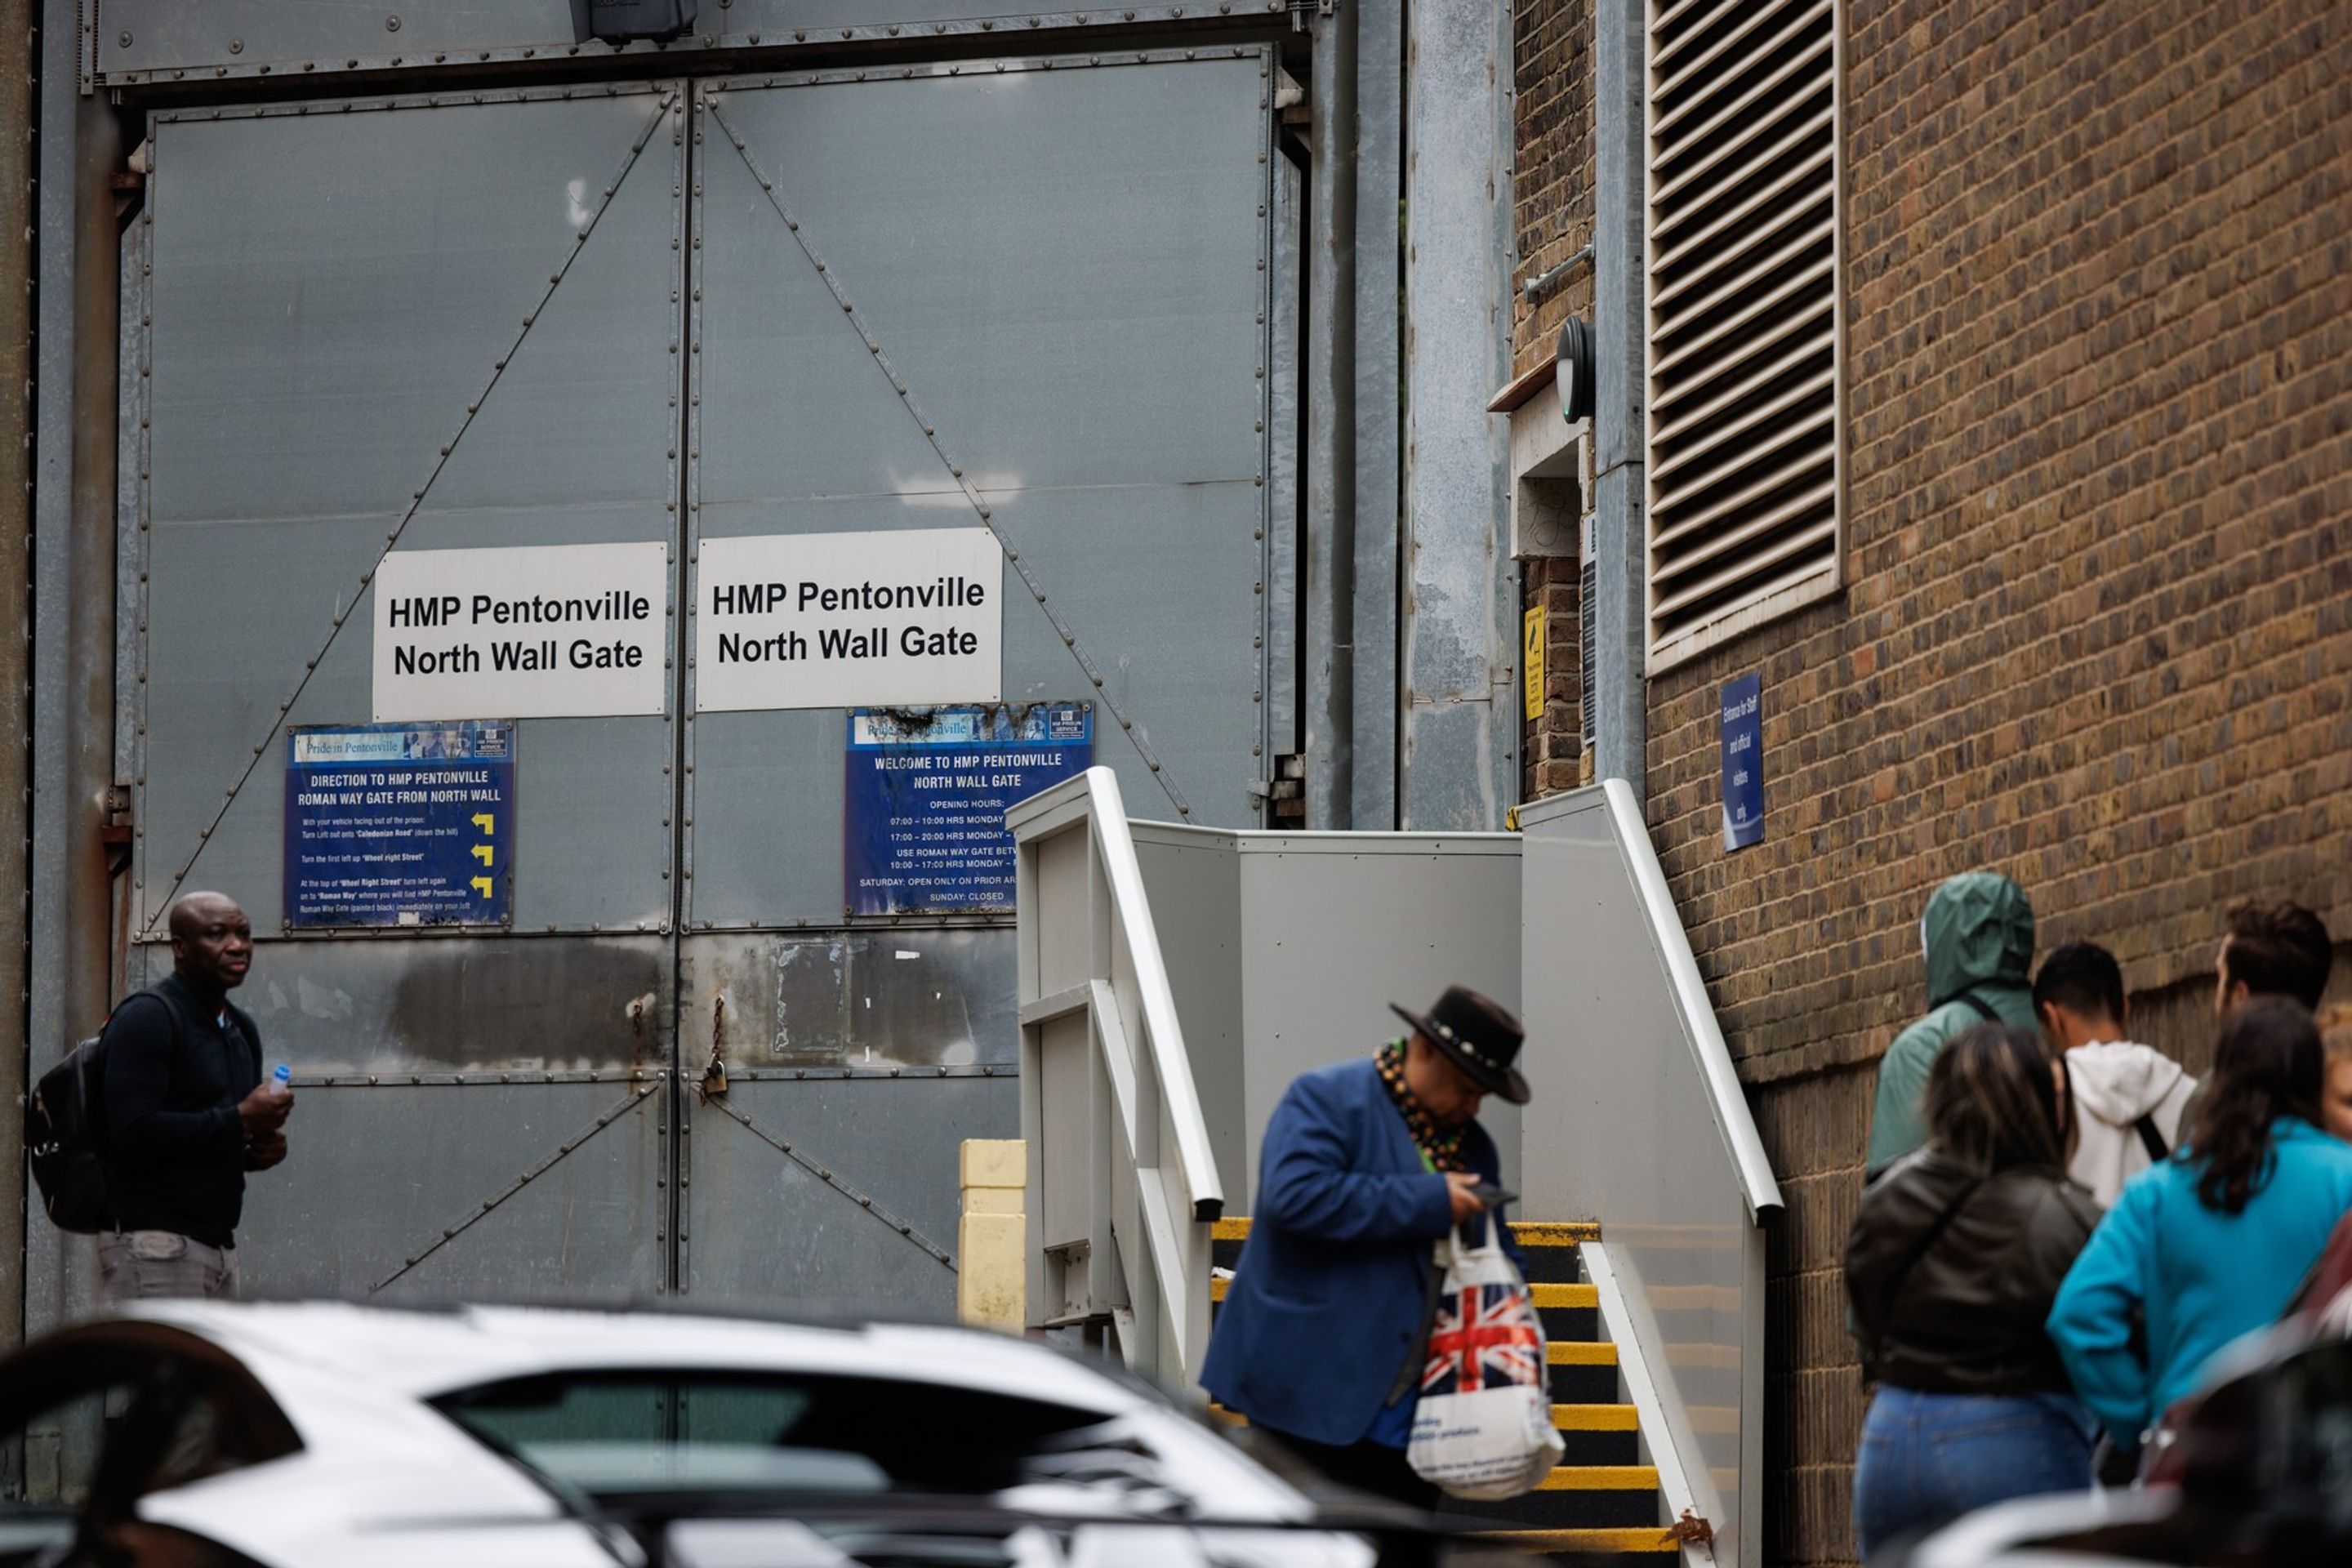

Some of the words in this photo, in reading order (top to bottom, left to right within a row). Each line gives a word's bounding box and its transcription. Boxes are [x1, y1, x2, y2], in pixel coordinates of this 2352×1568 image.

[713, 582, 786, 615] HMP
[799, 577, 984, 612] Pentonville
[390, 596, 460, 627] HMP
[471, 590, 649, 626] Pentonville
[718, 632, 807, 662] North
[819, 627, 888, 658] Wall
[900, 626, 978, 656] Gate
[394, 644, 479, 675] North
[491, 639, 556, 671] Wall
[568, 639, 642, 668] Gate
[307, 741, 332, 754] Pride
[333, 744, 342, 752] in
[345, 742, 398, 752] Pentonville
[875, 757, 931, 769] WELCOME
[936, 756, 949, 768] TO
[954, 756, 979, 767] HMP
[983, 753, 1062, 767] PENTONVILLE
[311, 774, 367, 787] DIRECTION
[371, 773, 385, 786] TO
[389, 773, 412, 785] HMP
[416, 771, 488, 784] PENTONVILLE
[915, 777, 952, 789] NORTH
[956, 776, 988, 787] WALL
[991, 774, 1021, 786] GATE
[298, 793, 336, 805] ROMAN
[340, 793, 363, 804] WAY
[367, 791, 393, 804] GATE
[398, 791, 427, 803] FROM
[431, 790, 468, 802] NORTH
[471, 789, 501, 801] WALL
[930, 801, 969, 809] OPENING
[354, 817, 372, 826] facing
[890, 817, 913, 826] 07:00
[923, 817, 944, 825] 10:00
[947, 816, 964, 824] HRS
[967, 816, 1004, 824] MONDAY
[922, 833, 944, 841] 20:00
[947, 832, 964, 840] HRS
[967, 831, 1004, 840] MONDAY
[916, 849, 947, 857] ROMAN
[950, 848, 969, 856] WAY
[971, 848, 993, 856] GATE
[891, 861, 913, 869] 10:00
[947, 860, 964, 868] HRS
[967, 859, 1004, 867] MONDAY
[860, 879, 906, 887] SATURDAY:
[908, 878, 932, 886] OPEN
[959, 877, 972, 885] ON
[974, 876, 1001, 884] PRIOR
[930, 893, 966, 902] SUNDAY:
[969, 892, 1004, 900] CLOSED
[322, 905, 334, 913] Way
